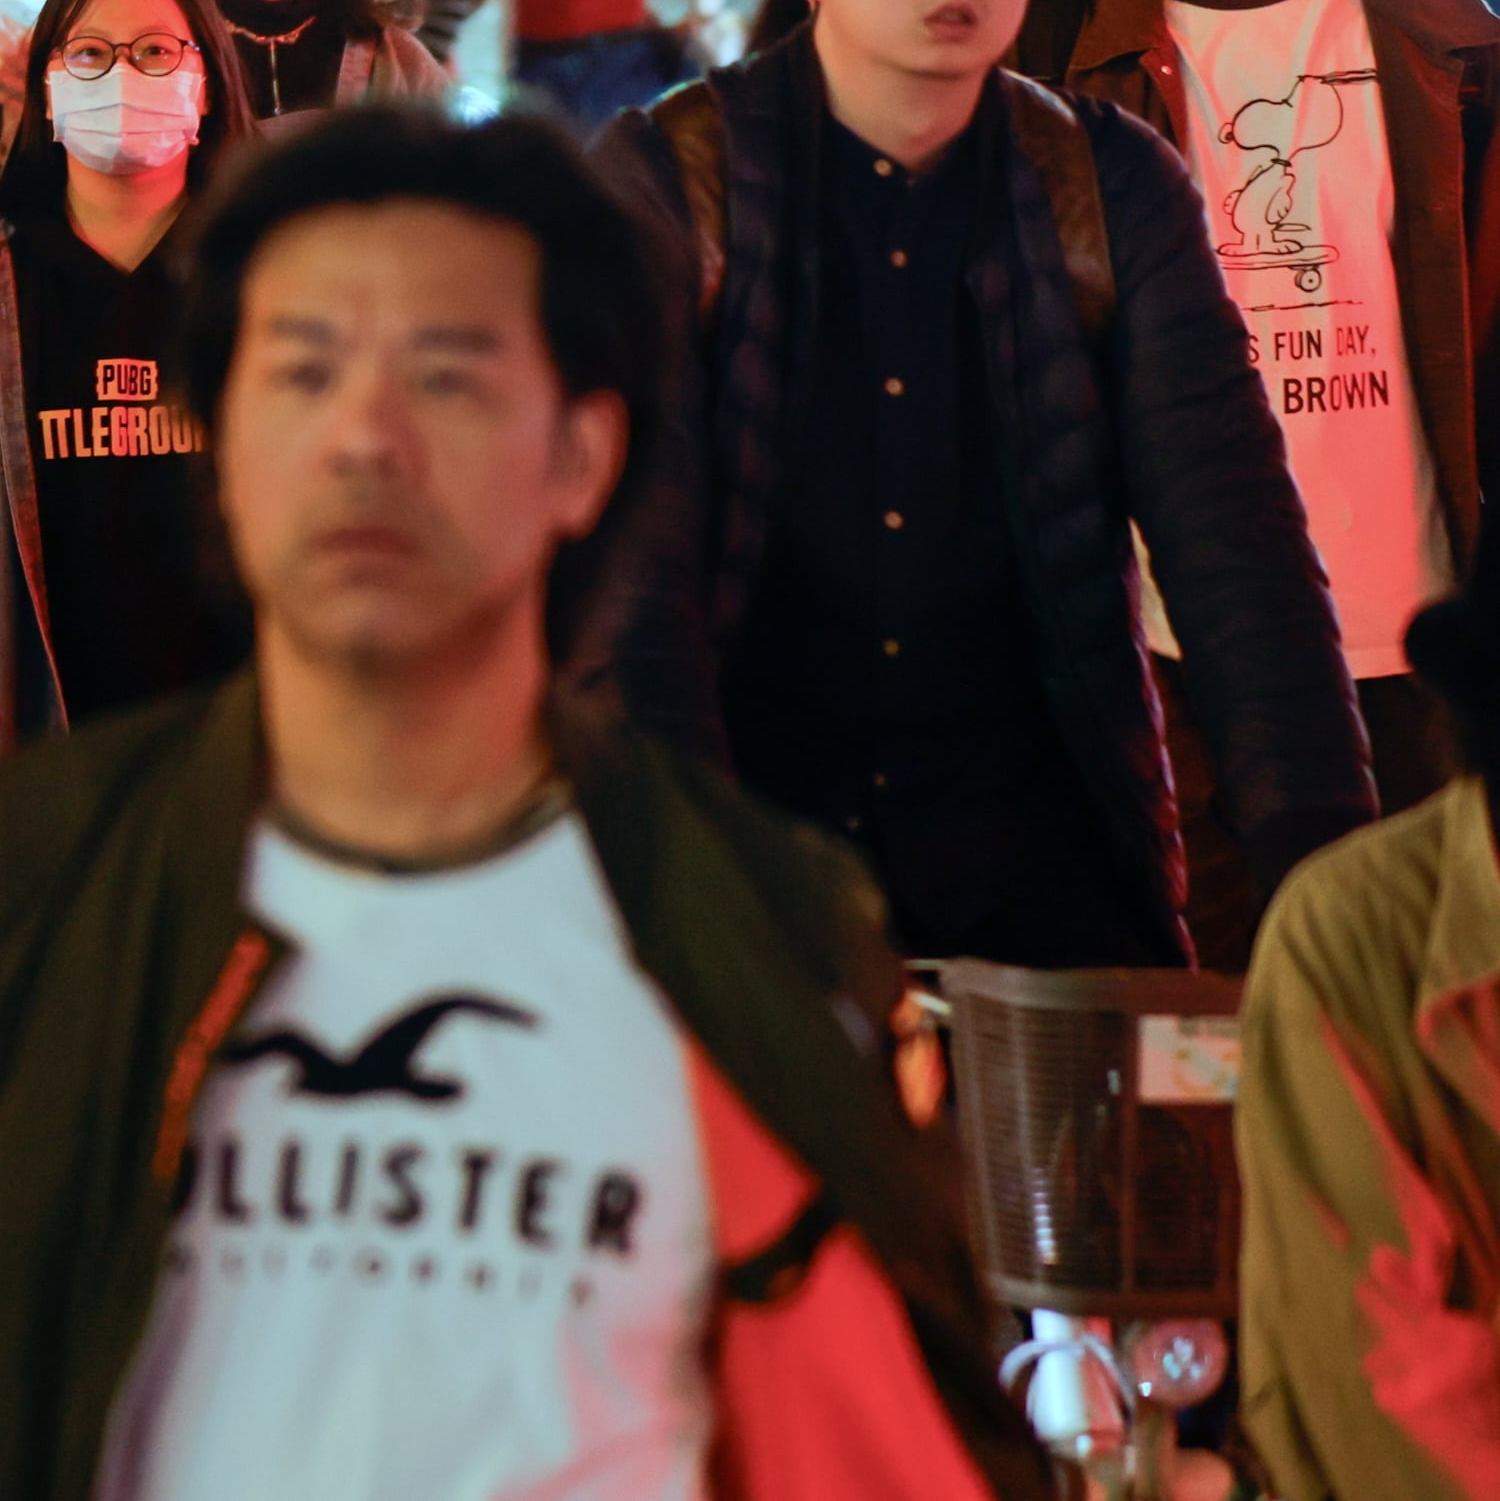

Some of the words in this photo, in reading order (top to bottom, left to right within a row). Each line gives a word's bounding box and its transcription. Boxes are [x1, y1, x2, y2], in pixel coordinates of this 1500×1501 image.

[1274, 329, 1322, 361] FUN
[1336, 324, 1376, 356] DAY,
[103, 364, 152, 395] PUBG
[1284, 370, 1389, 414] BROWN
